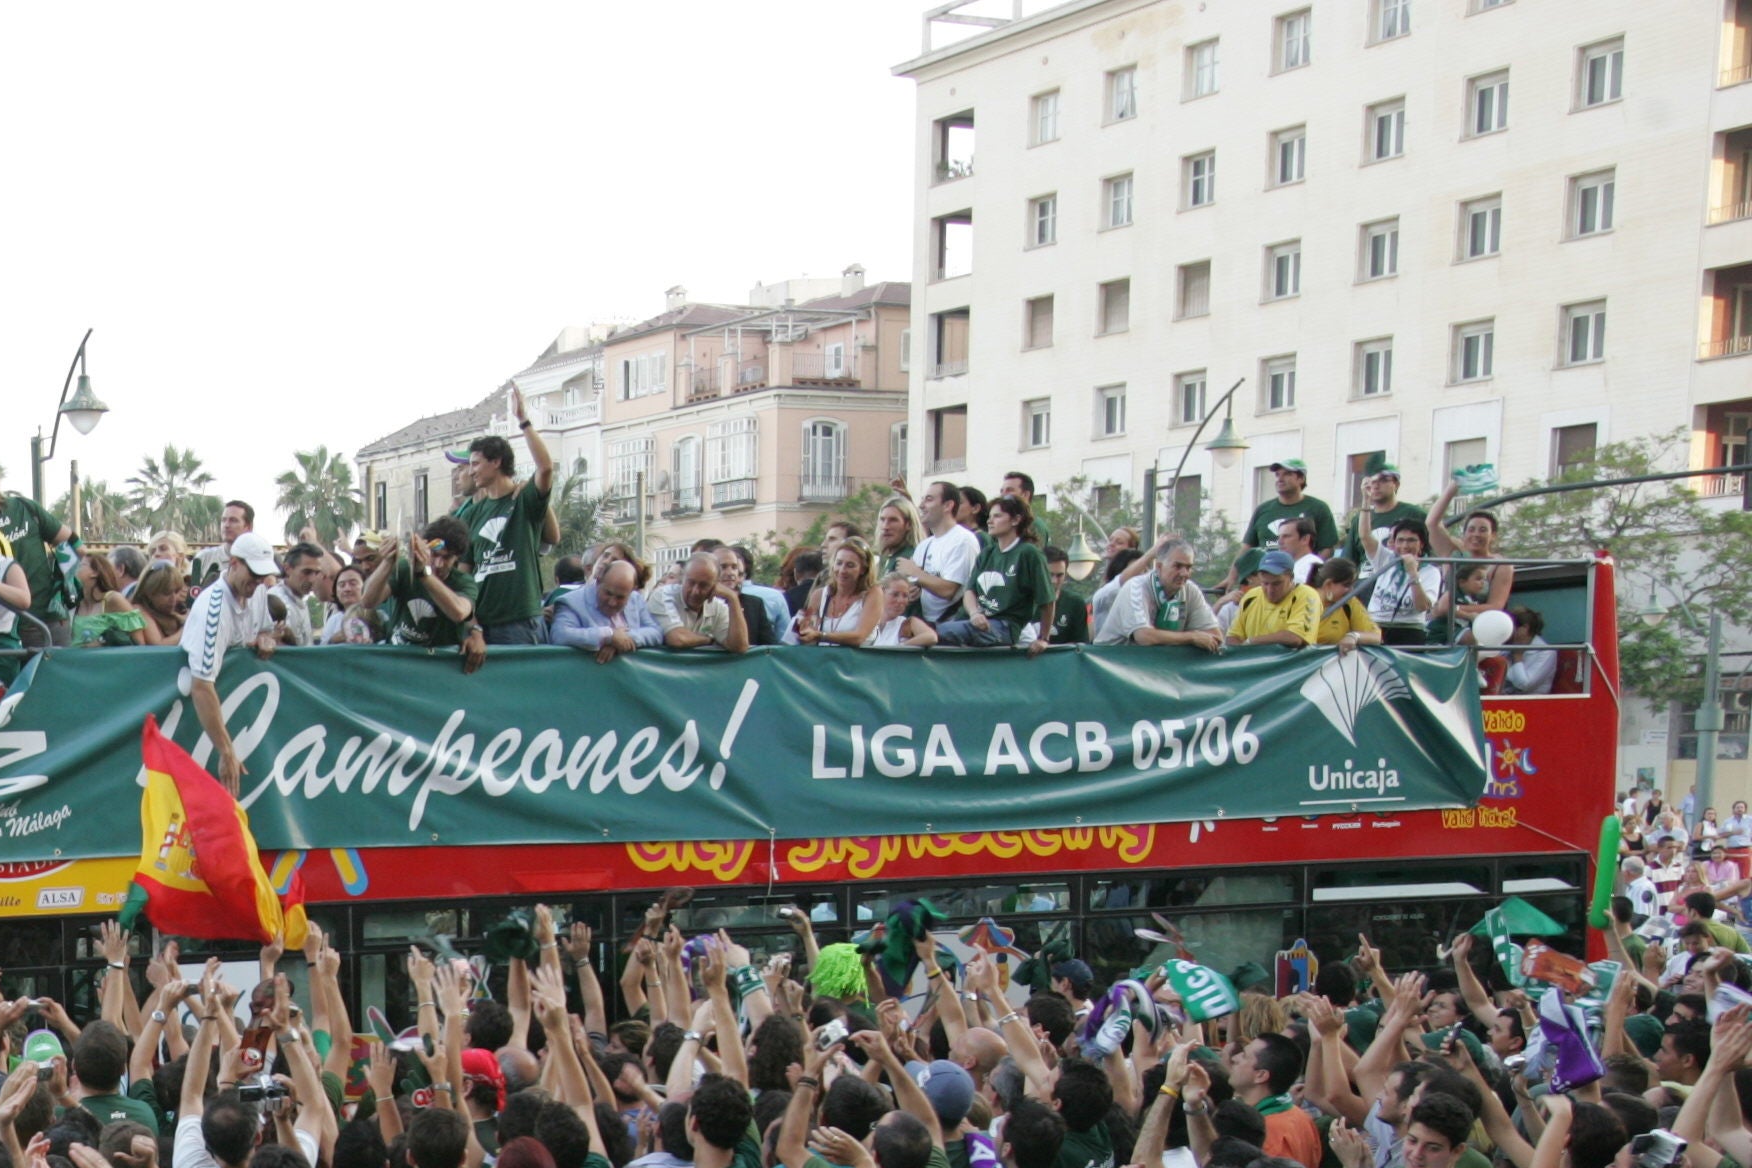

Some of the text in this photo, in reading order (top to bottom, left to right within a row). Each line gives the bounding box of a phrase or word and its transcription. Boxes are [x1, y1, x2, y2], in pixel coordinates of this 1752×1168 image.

[811, 723, 967, 779] LIGA
[983, 721, 1114, 777] ACB
[1131, 713, 1261, 770] 05/06
[1309, 757, 1400, 796] Unicaja
[5, 804, 72, 838] Málaga
[41, 891, 77, 905] ALSA
